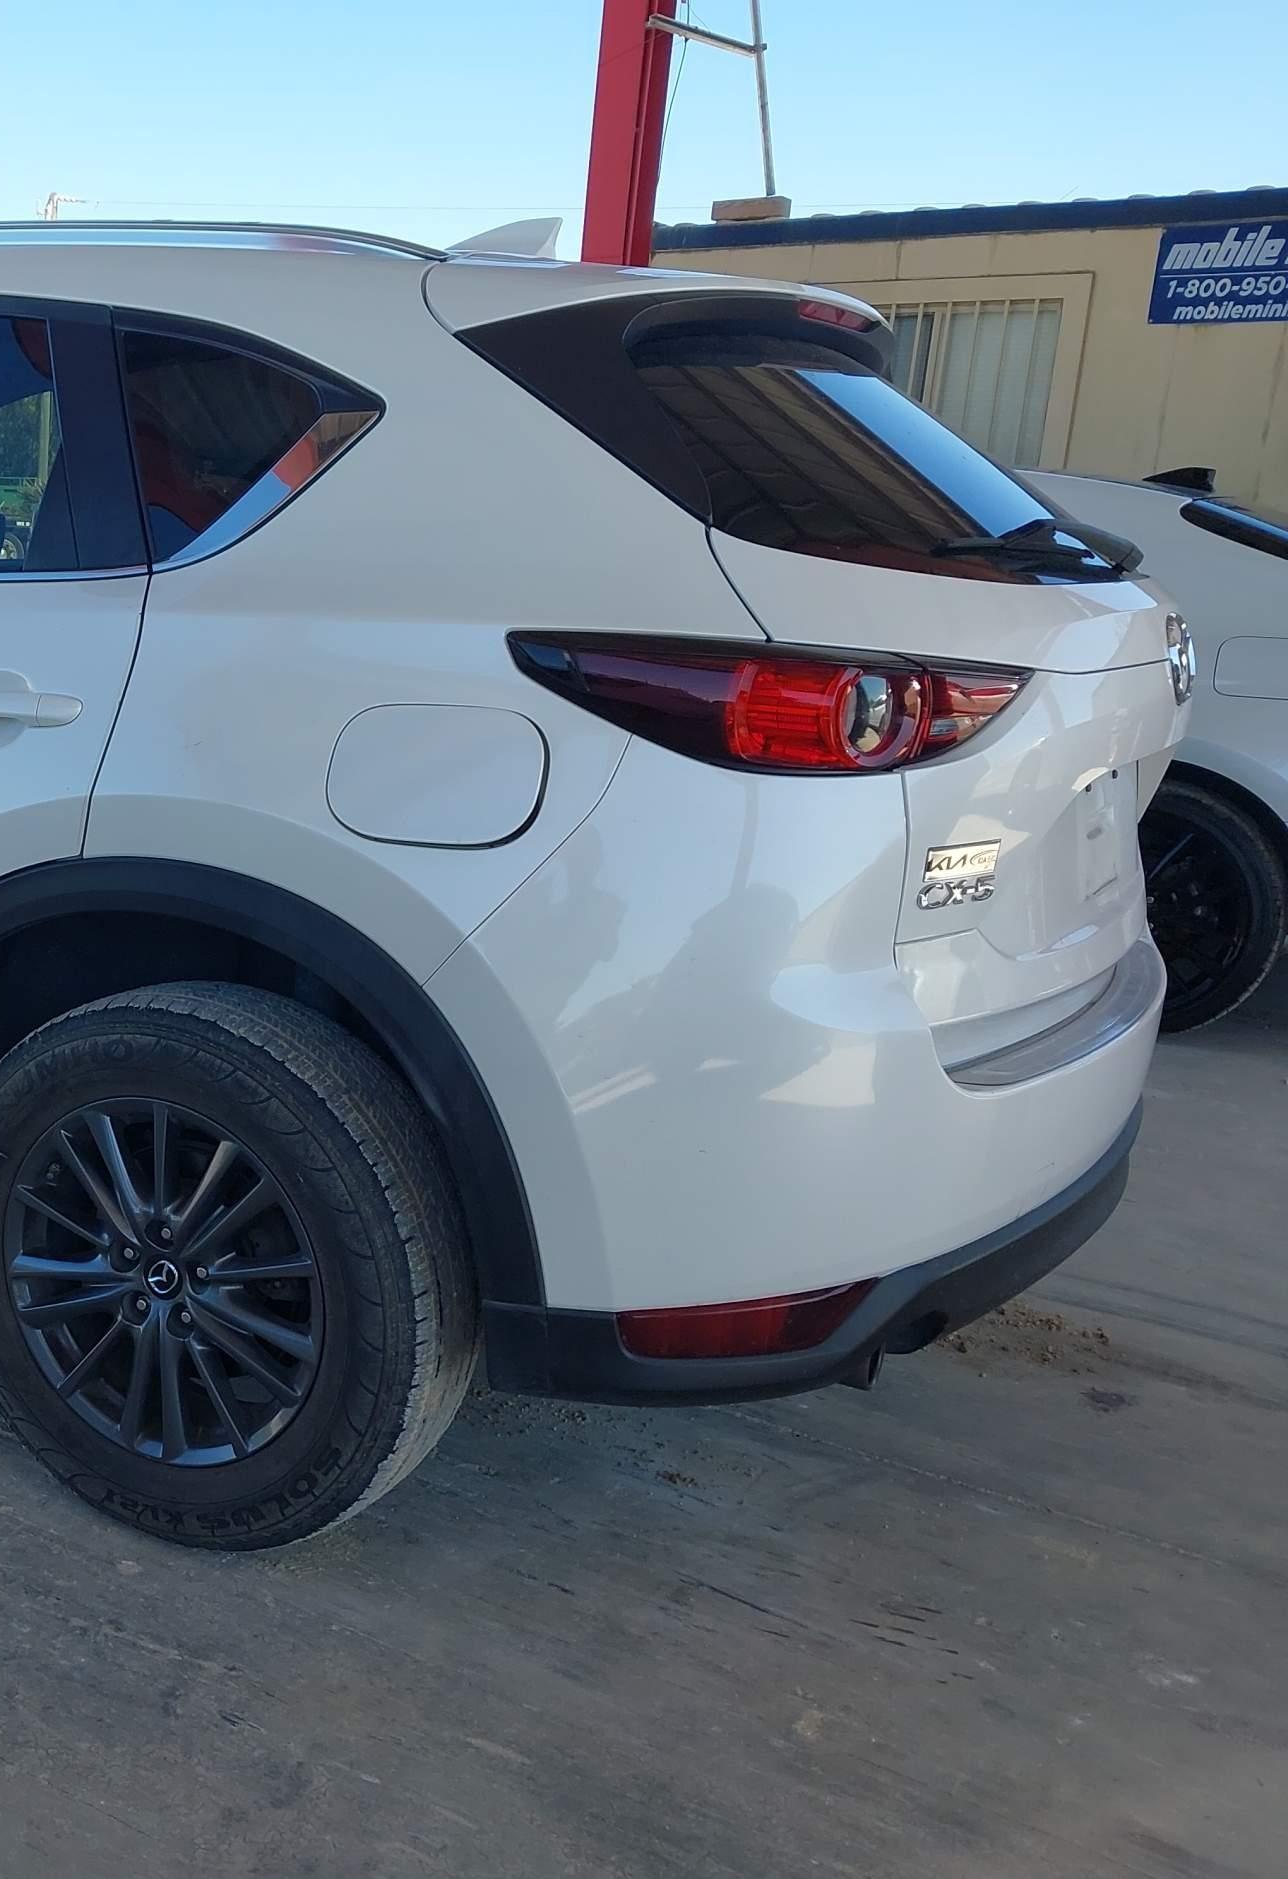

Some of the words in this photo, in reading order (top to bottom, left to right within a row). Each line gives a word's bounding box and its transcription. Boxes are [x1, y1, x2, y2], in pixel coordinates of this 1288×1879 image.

[1163, 225, 1286, 269] mobile
[1167, 276, 1288, 298] 1-800-950
[916, 875, 996, 910] CX-5
[196, 1447, 342, 1530] SOLUS
